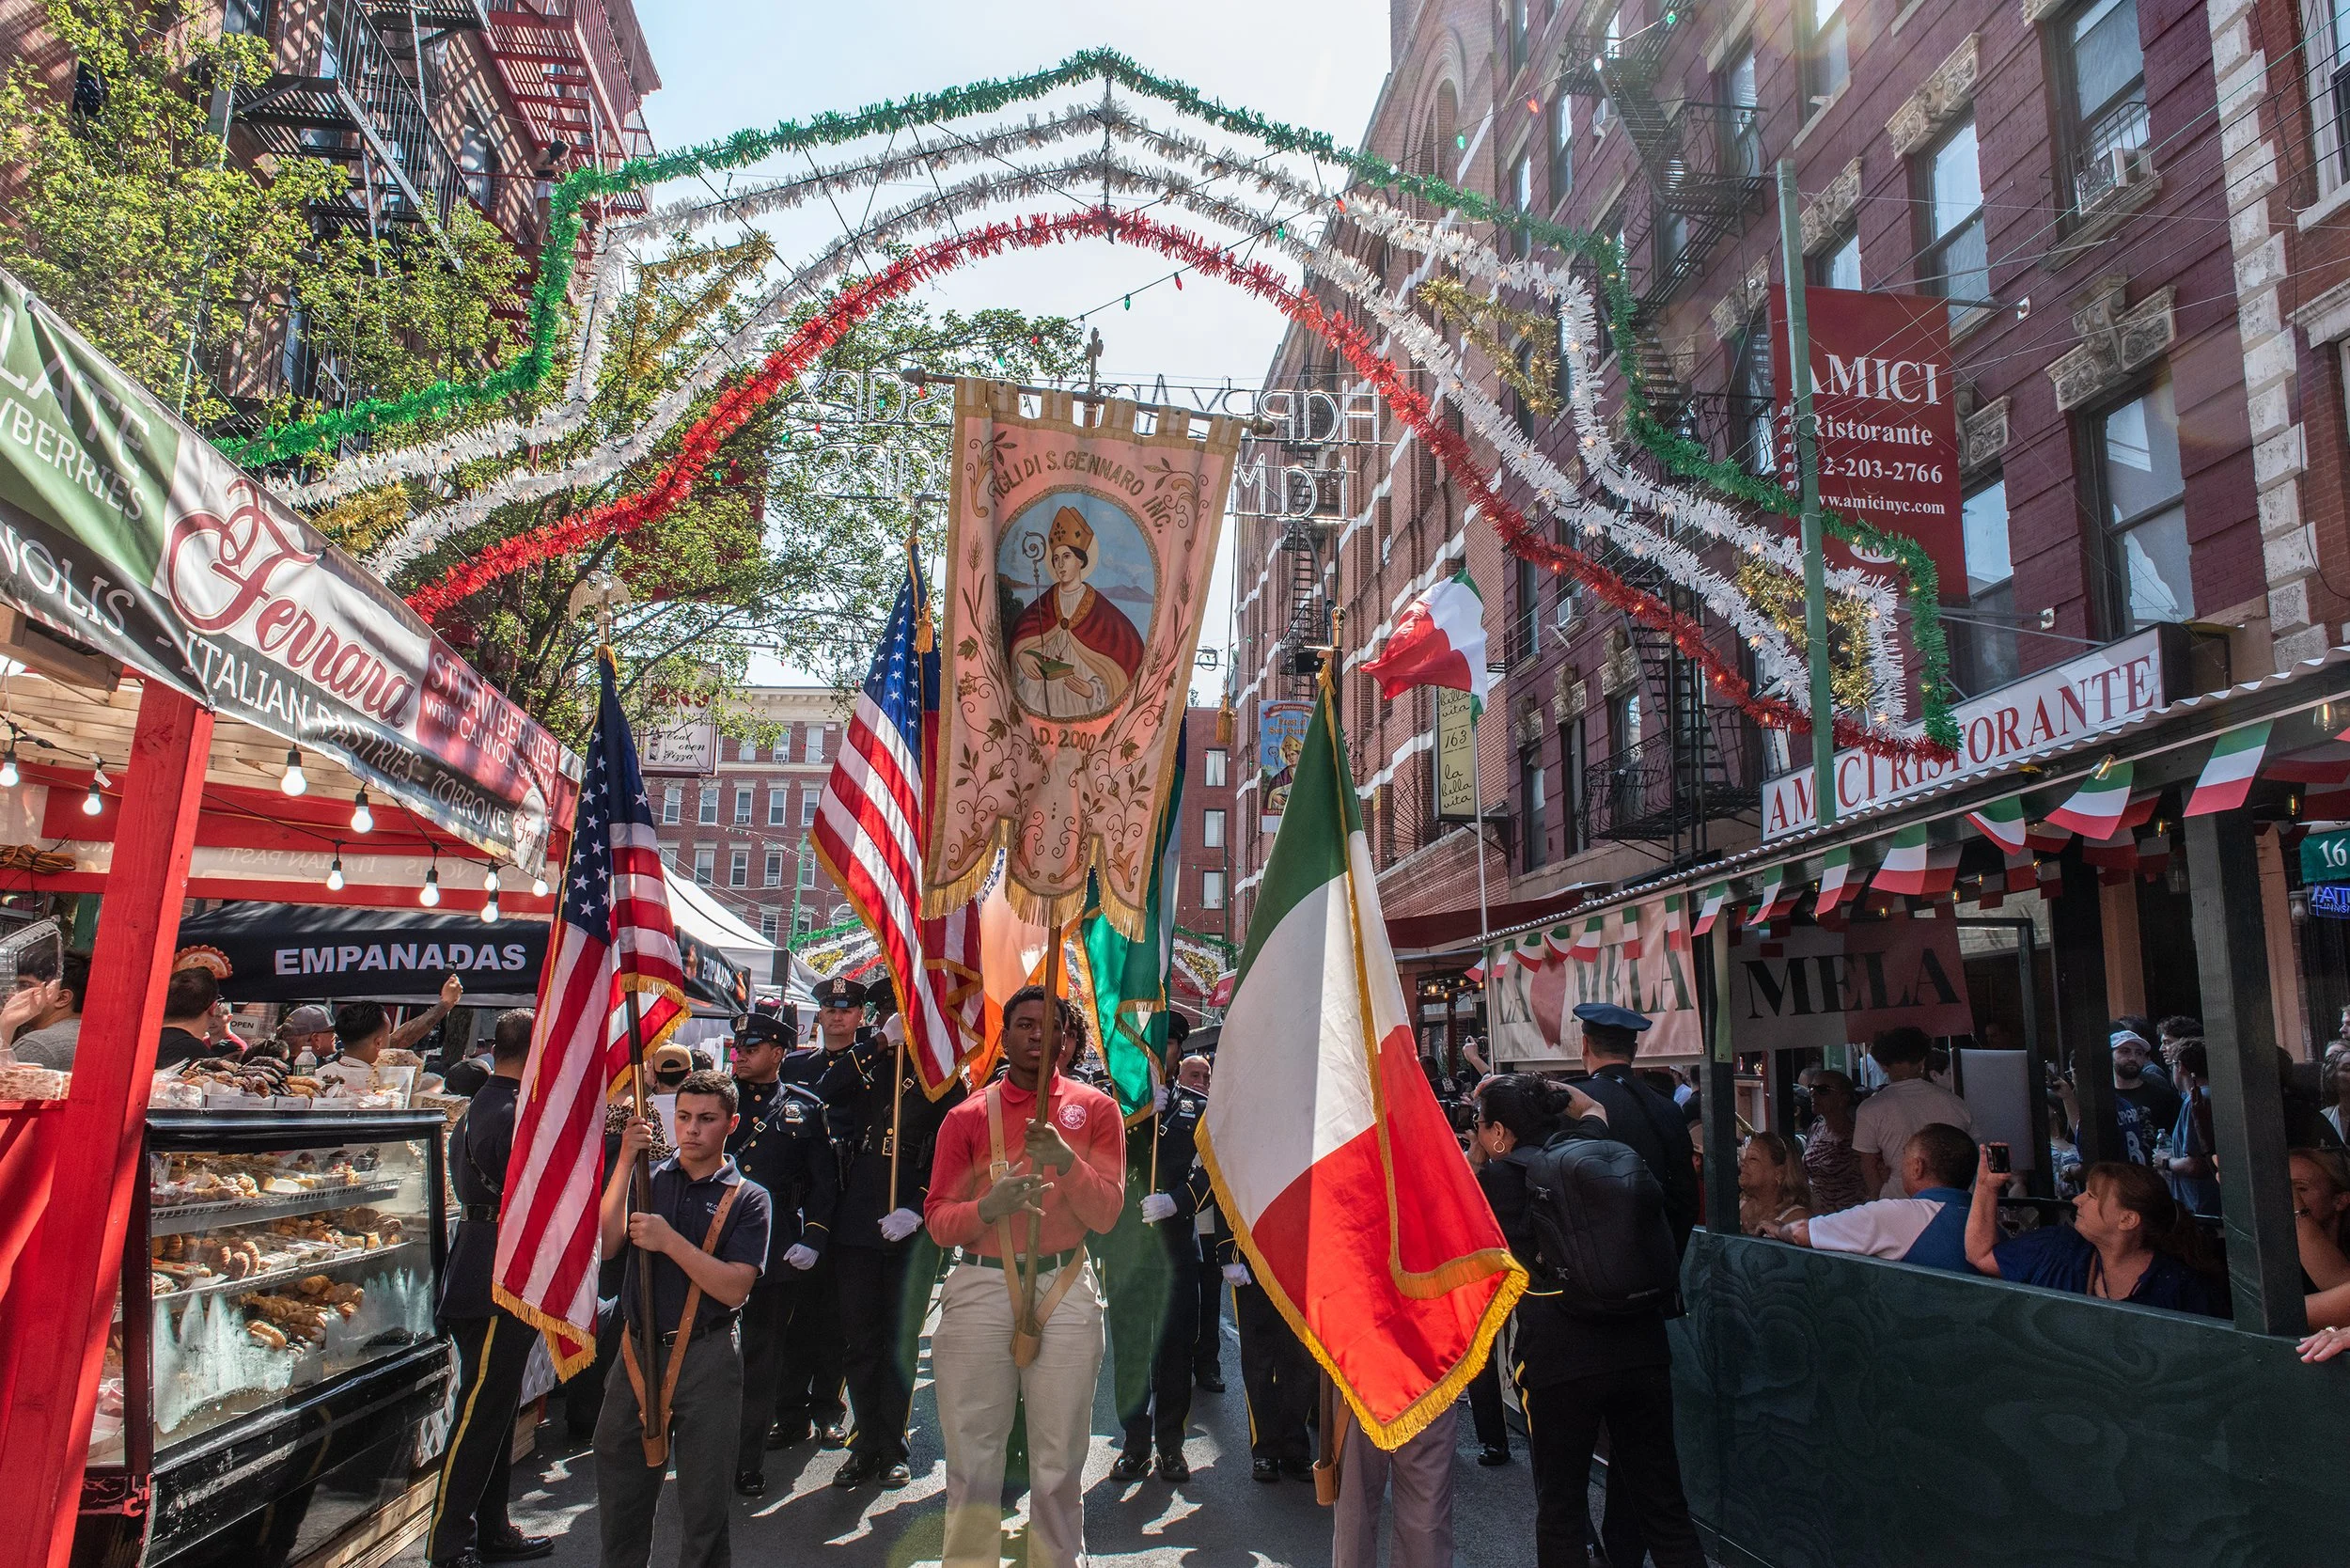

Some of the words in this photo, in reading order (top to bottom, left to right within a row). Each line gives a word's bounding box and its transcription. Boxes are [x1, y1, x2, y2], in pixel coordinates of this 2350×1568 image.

[1814, 414, 1934, 447] Ristorante
[1818, 456, 1943, 484] 2-203-2766
[1024, 454, 1042, 478] DI
[1063, 450, 1145, 496] GENNARO
[1141, 495, 1171, 534] INC.
[1819, 494, 1945, 515] w.amicinyc.com
[164, 475, 415, 731] Ferrara
[431, 651, 556, 775] STRAWBERRIES
[1442, 704, 1470, 717] vita
[183, 630, 309, 730] ITALIAN
[316, 701, 421, 784] PASTRIES
[430, 769, 509, 838] TORRONE
[424, 695, 456, 731] with
[459, 716, 516, 772] CANNOLI
[666, 731, 694, 741] Coal
[1058, 729, 1096, 752] 2000
[1444, 729, 1467, 749] 163
[663, 750, 694, 762] Pizza
[1445, 764, 1464, 780] la
[1441, 778, 1472, 797] bella
[1767, 752, 1878, 834] AMCI
[1444, 794, 1472, 809] vita
[275, 944, 526, 975] EMPANADAS
[1740, 948, 1963, 1019] MELA
[230, 1020, 254, 1029] OPEN
